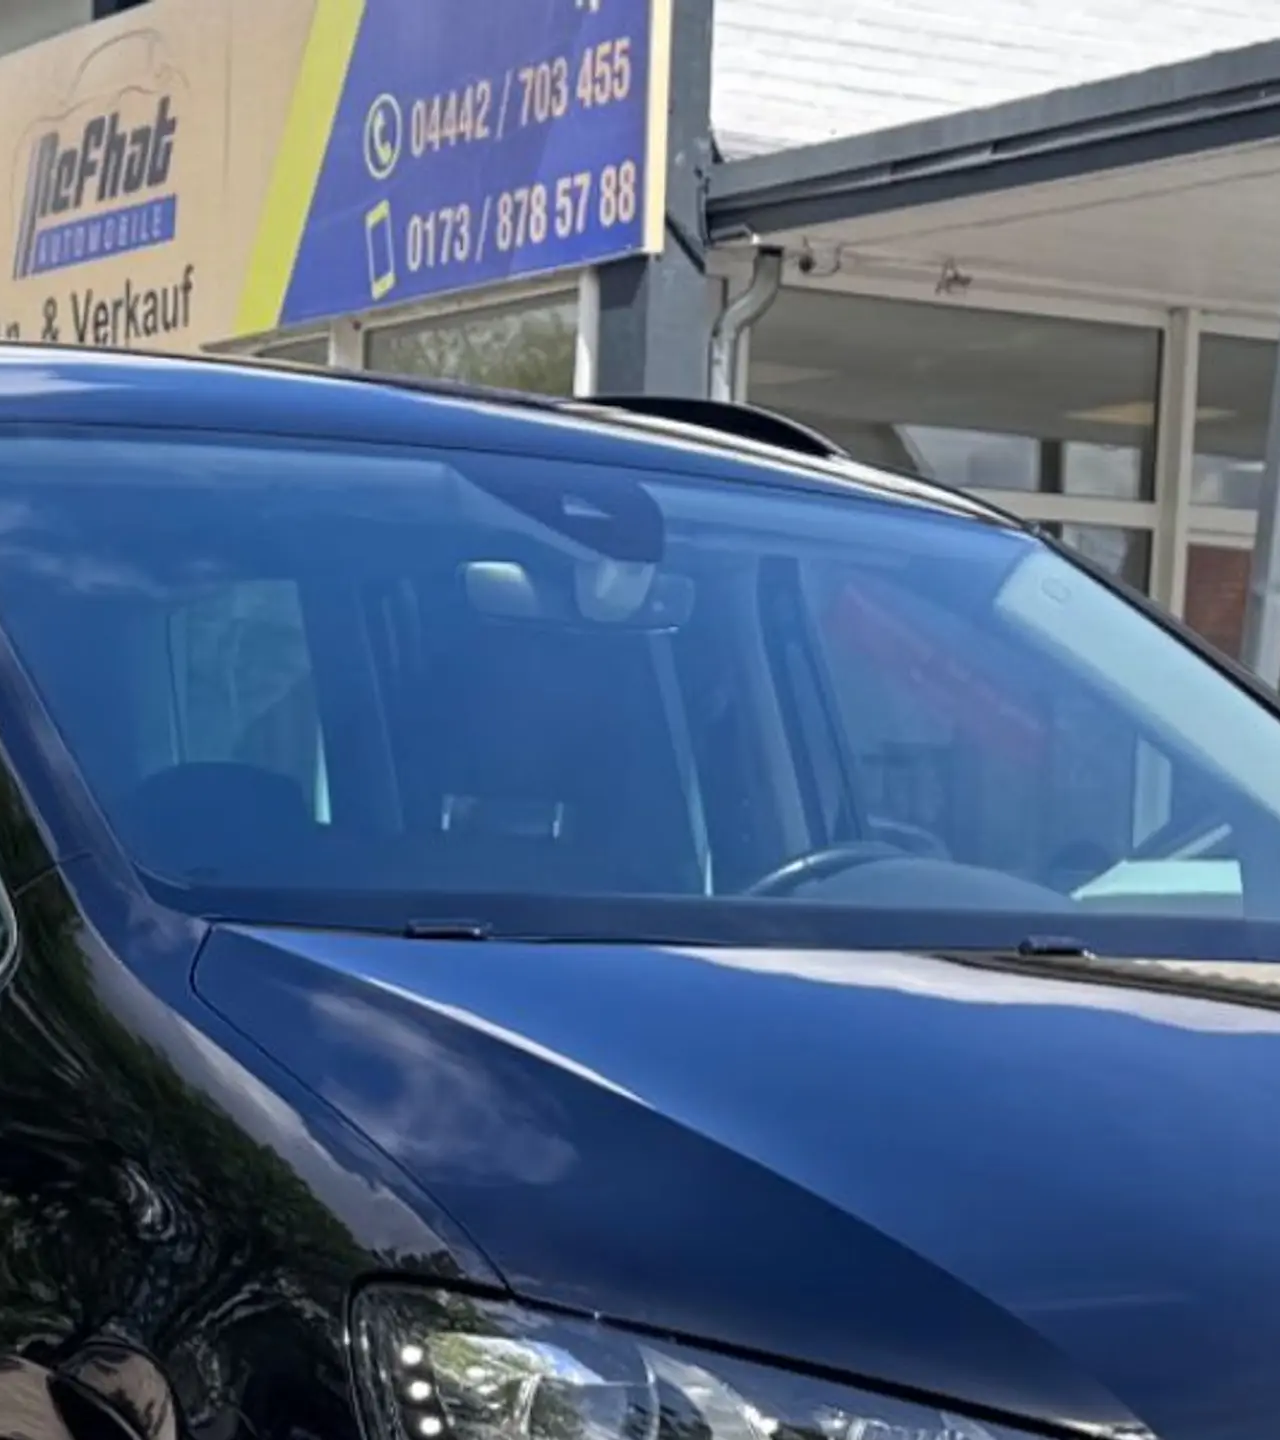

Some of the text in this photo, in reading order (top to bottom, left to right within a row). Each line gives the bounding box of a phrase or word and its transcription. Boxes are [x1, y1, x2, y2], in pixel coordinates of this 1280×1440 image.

[411, 80, 491, 157] 04442
[518, 56, 568, 127] 703
[577, 37, 631, 108] 455
[36, 203, 163, 266] AUTOMOBILE
[406, 203, 470, 272] 0173
[496, 184, 547, 250] 878
[555, 172, 591, 238] 57
[599, 160, 636, 228] 88
[71, 263, 195, 347] Verkauf
